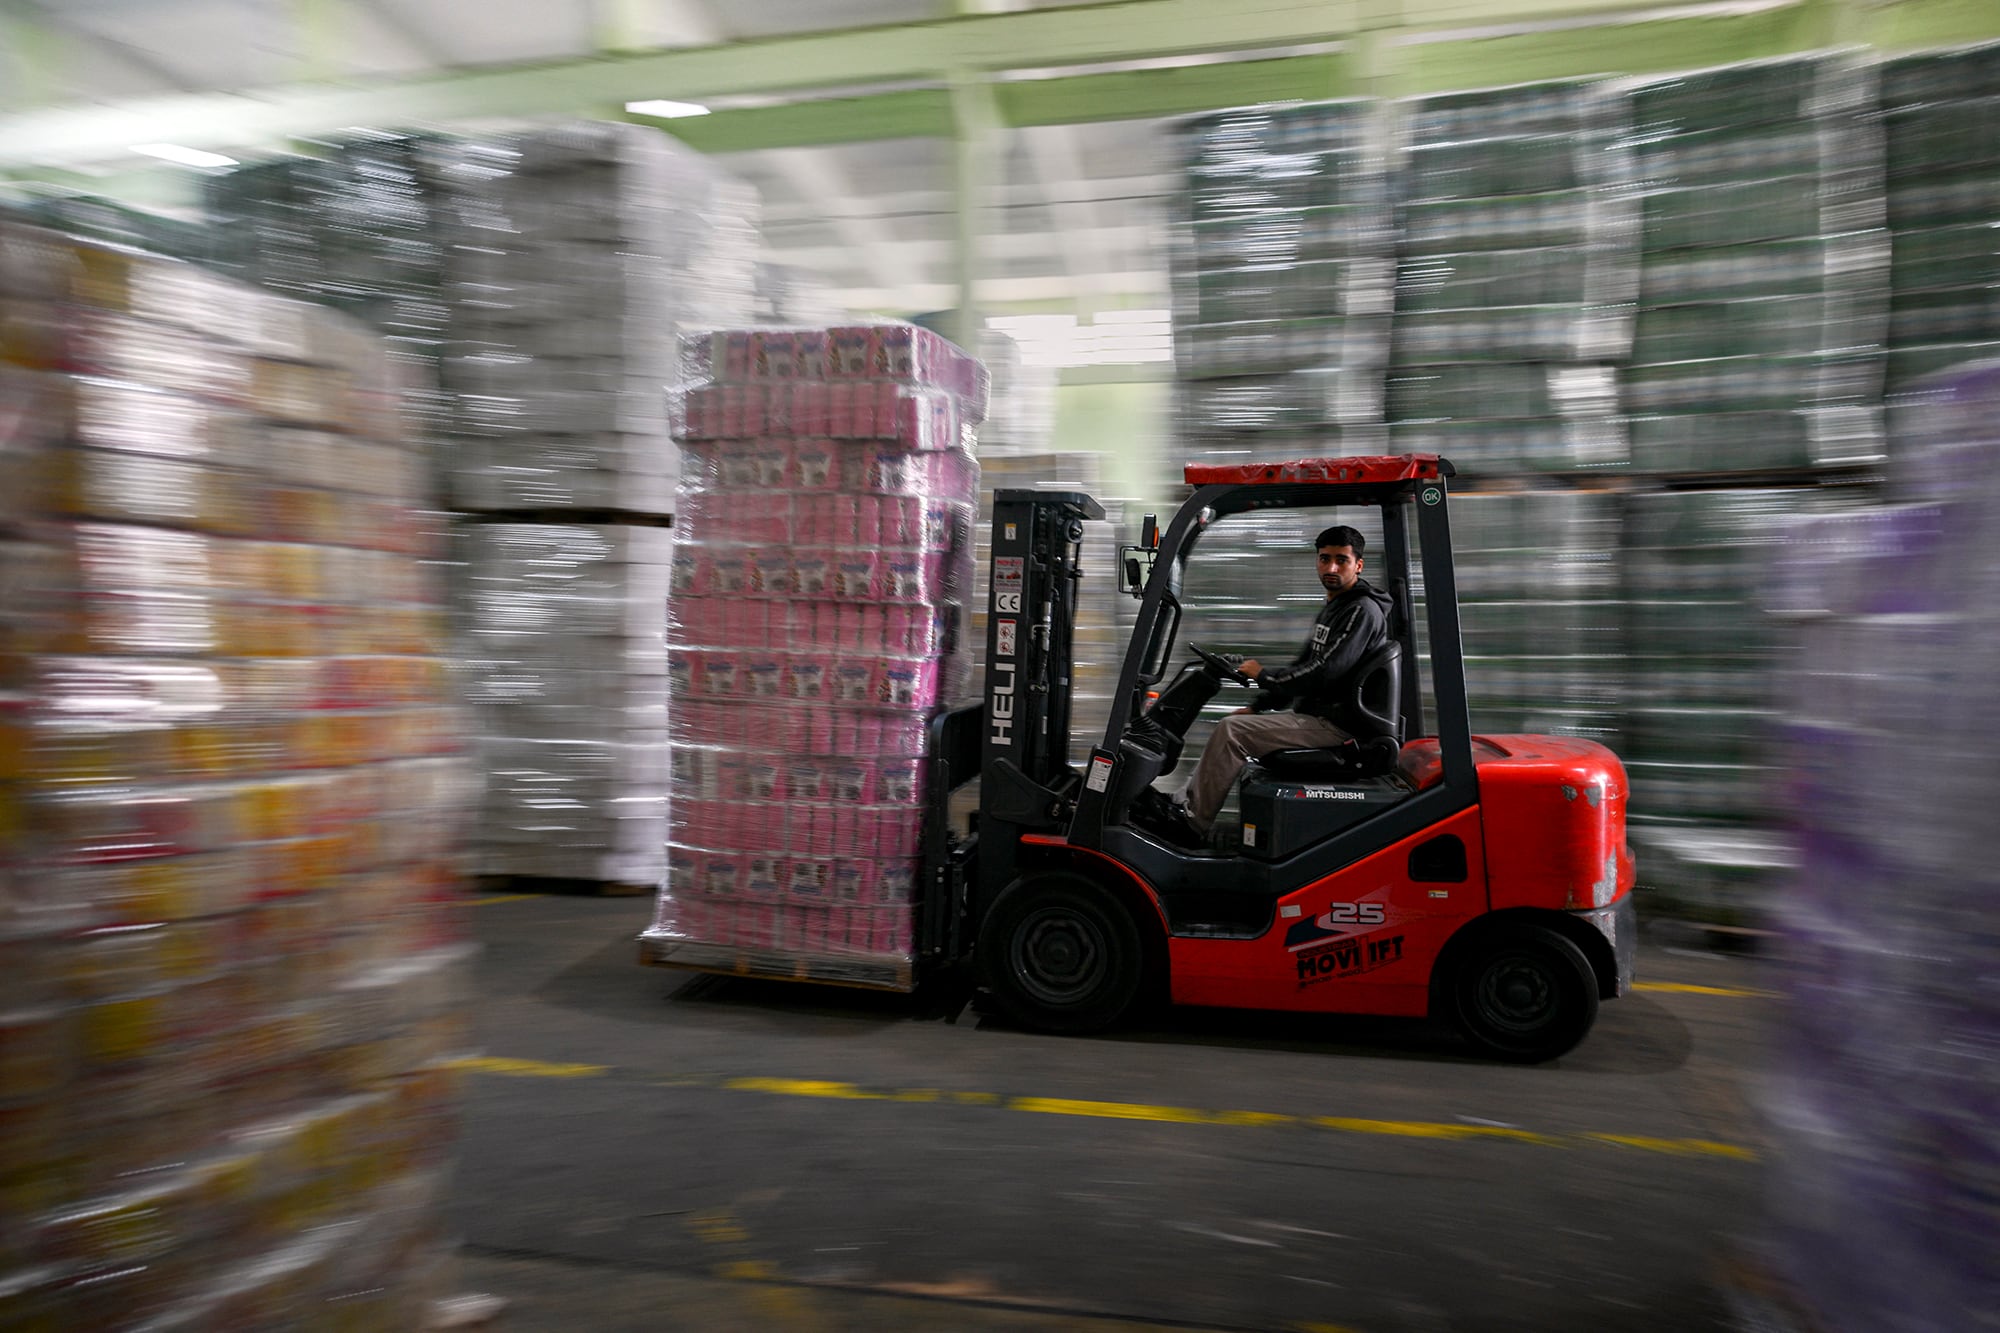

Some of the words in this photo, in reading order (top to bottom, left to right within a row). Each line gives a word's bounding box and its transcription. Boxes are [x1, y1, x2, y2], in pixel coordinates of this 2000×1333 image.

[1280, 467, 1347, 480] HELI
[1425, 492, 1438, 501] OK
[998, 595, 1019, 610] CE
[991, 662, 1016, 746] HELI
[1305, 789, 1365, 800] MITSUBISHI
[1331, 902, 1384, 925] 25
